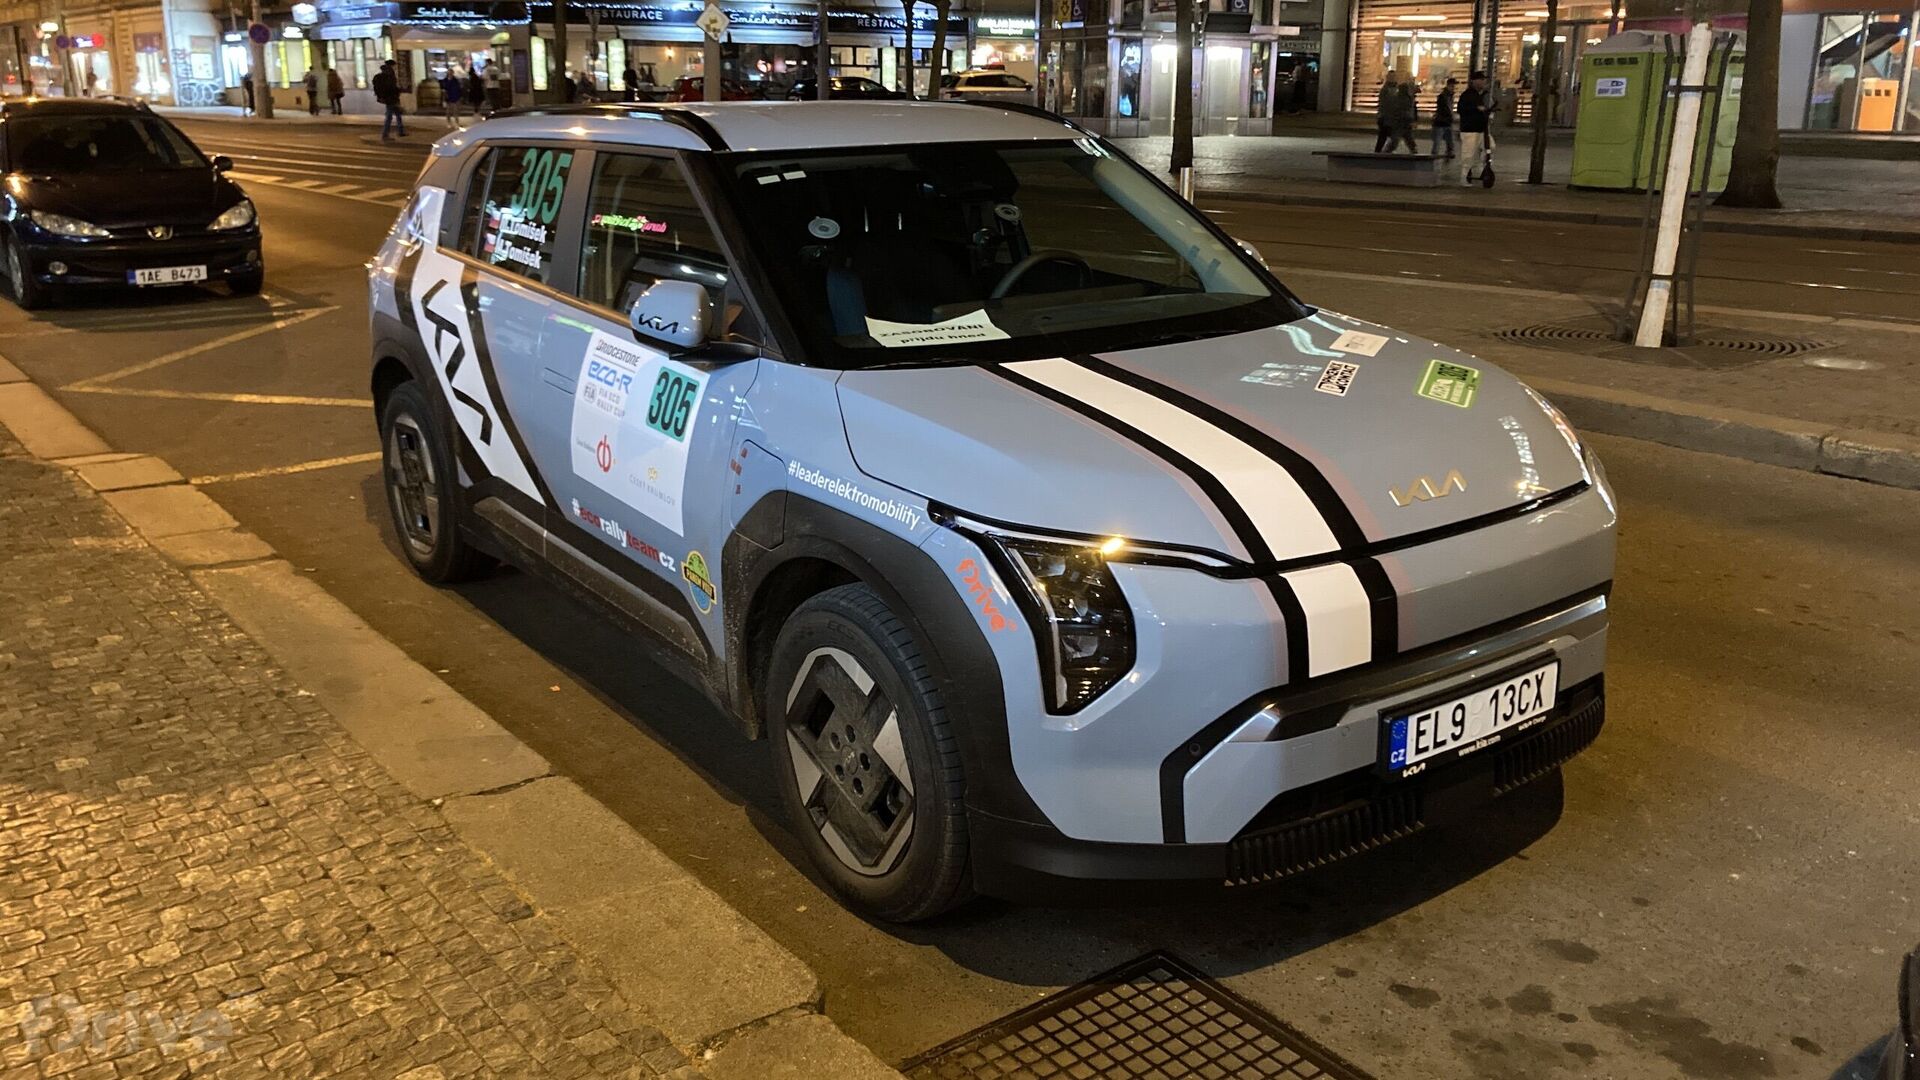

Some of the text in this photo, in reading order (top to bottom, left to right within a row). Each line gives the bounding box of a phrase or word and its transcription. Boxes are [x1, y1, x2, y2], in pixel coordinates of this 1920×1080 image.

[584, 8, 664, 21] RESTAURACE
[857, 18, 924, 29] RESTAURCE
[511, 148, 573, 224] 305
[140, 267, 201, 282] 1AE B473
[947, 332, 986, 340] hned
[596, 339, 641, 367] BRIDGESTONE
[649, 370, 698, 438] 305
[788, 459, 921, 531] #leaderelektromobility
[571, 497, 677, 573] #ecorallyteamcz
[1415, 671, 1545, 756] EL9 13CX
[1391, 748, 1405, 763] CZ
